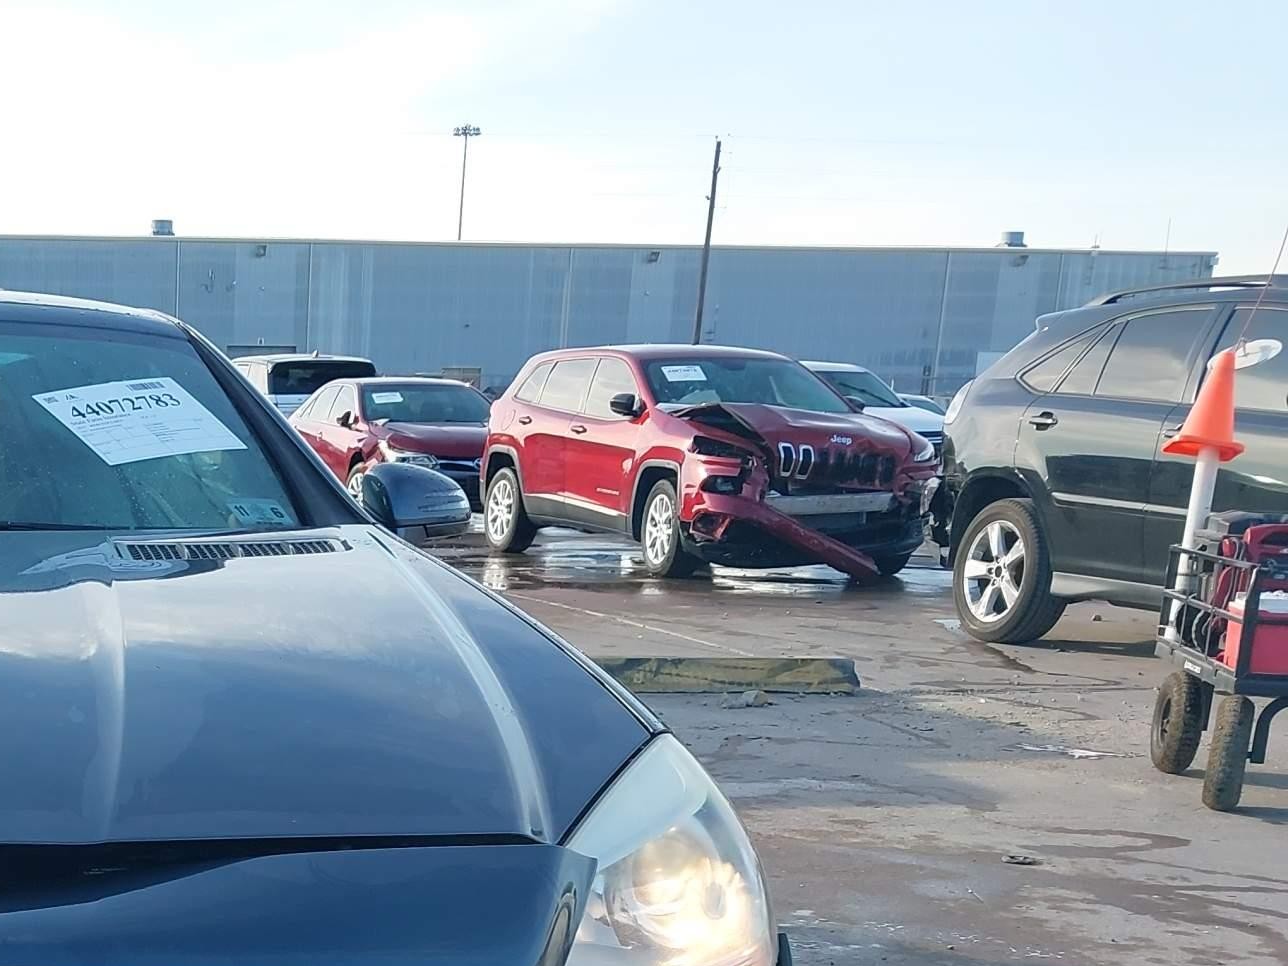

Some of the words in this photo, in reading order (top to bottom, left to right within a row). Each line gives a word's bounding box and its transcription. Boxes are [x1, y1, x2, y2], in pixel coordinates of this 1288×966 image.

[71, 393, 181, 419] 44072783
[830, 434, 853, 446] Jeep
[234, 504, 250, 517] 11
